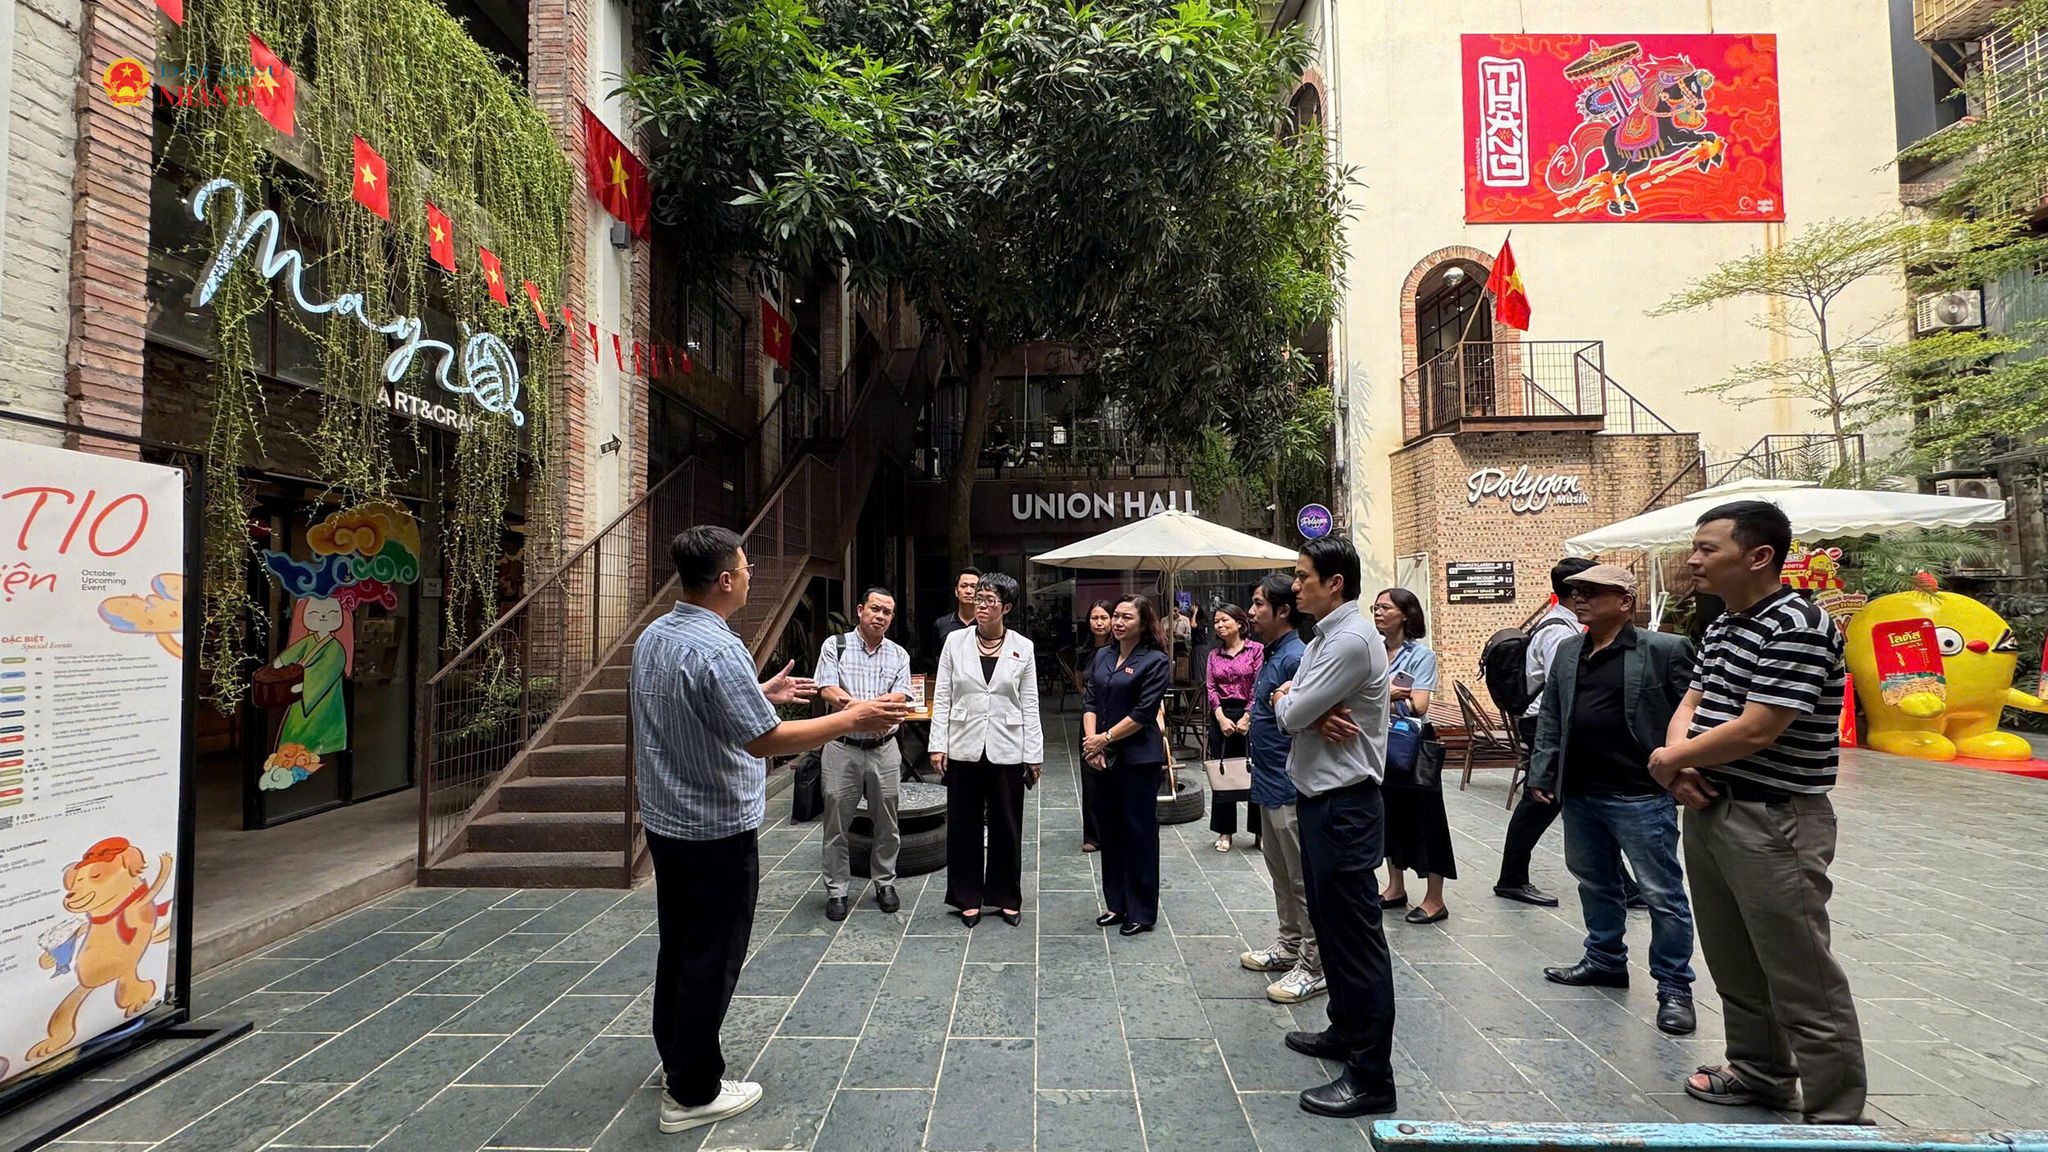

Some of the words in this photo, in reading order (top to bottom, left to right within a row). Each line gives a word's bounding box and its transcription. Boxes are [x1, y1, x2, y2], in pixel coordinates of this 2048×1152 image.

[1467, 464, 1581, 512] Polygon
[1556, 495, 1590, 504] Musik
[1012, 492, 1115, 520] UNION
[81, 569, 117, 577] October
[81, 577, 127, 586] Upcoming
[81, 584, 107, 592] Event
